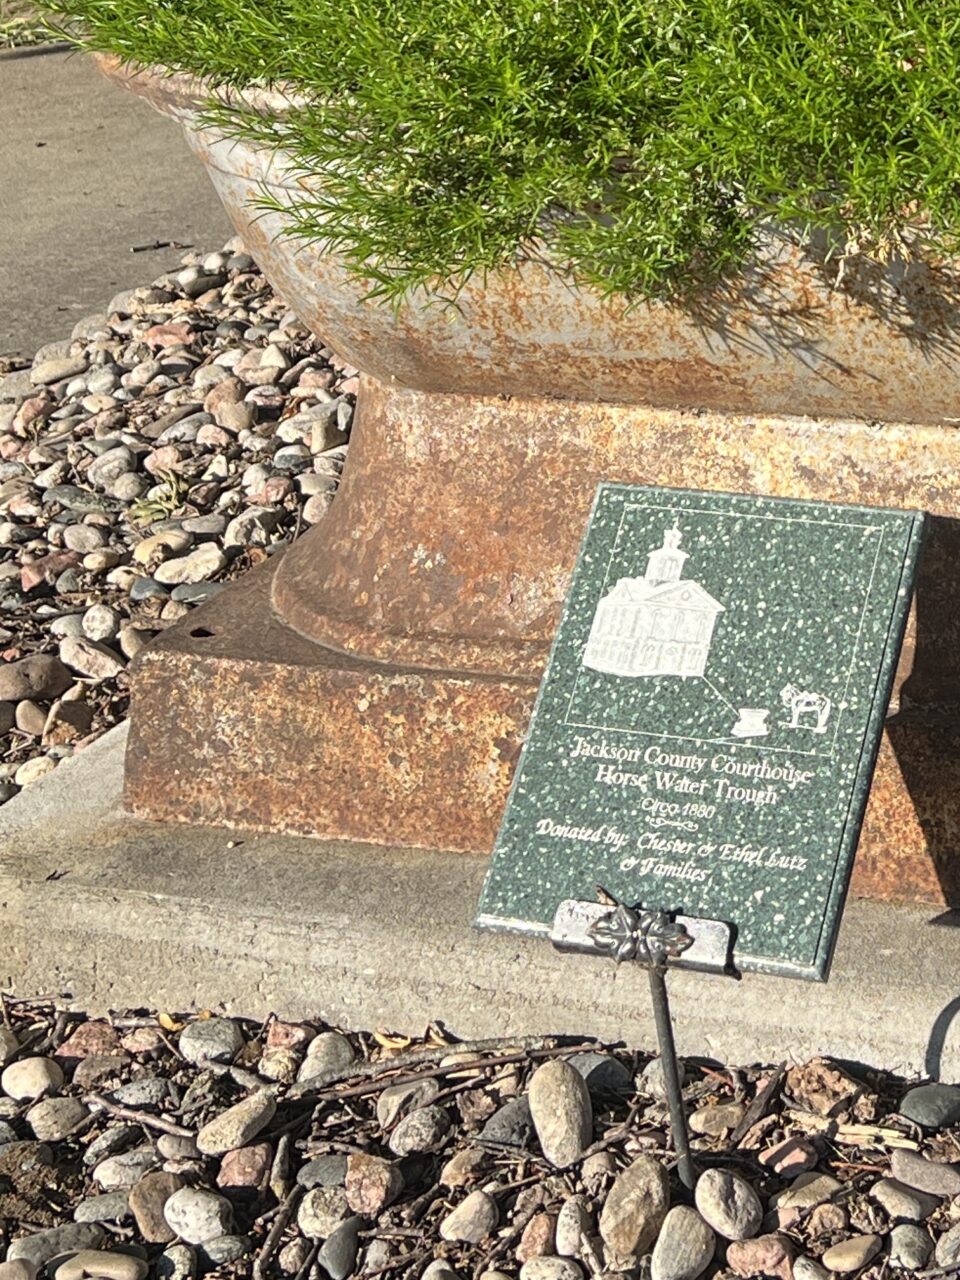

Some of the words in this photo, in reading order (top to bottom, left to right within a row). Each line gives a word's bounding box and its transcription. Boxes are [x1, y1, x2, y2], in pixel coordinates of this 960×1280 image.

[570, 735, 641, 762] Jackson
[644, 746, 707, 773] County
[711, 754, 814, 783] Courthouse
[594, 764, 648, 787] Horse
[655, 770, 710, 795] Water
[714, 778, 777, 806] Trough
[682, 802, 716, 819] 1880
[535, 818, 605, 842] Donated
[603, 825, 630, 852] by:
[637, 832, 696, 854] Chester
[697, 842, 717, 856] &
[719, 844, 769, 866] Ethel
[764, 849, 808, 871] Lutz
[620, 856, 640, 870] &
[639, 857, 710, 881] Families
